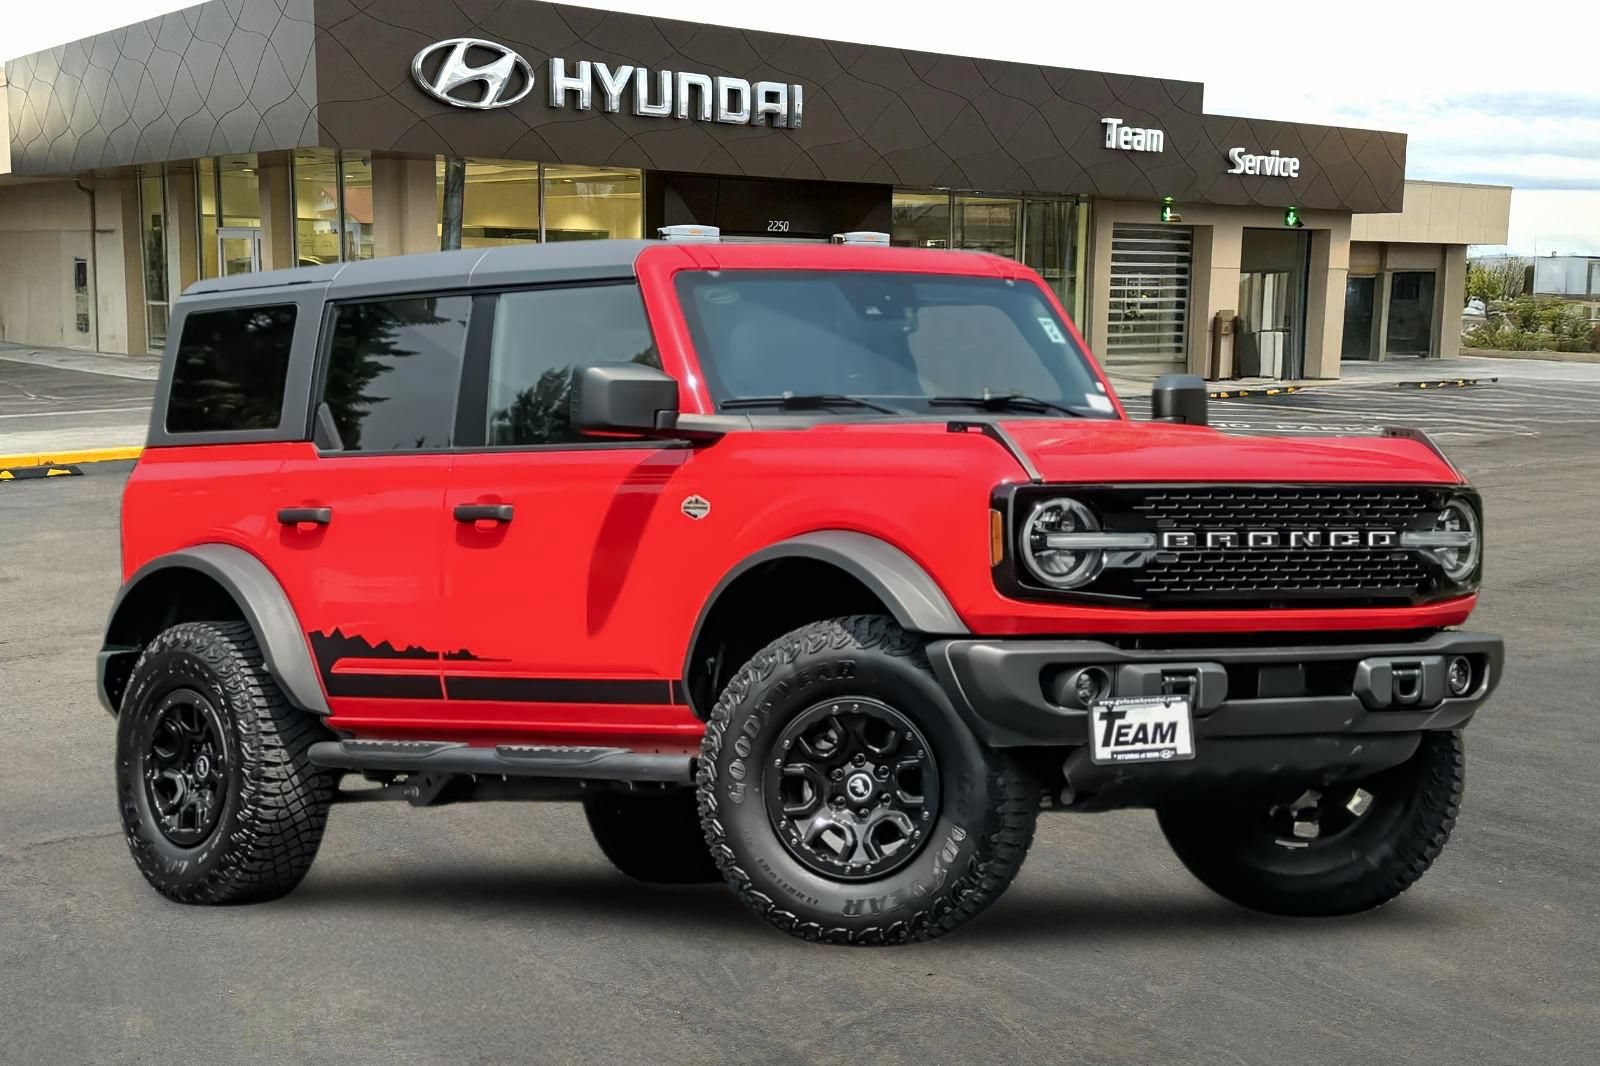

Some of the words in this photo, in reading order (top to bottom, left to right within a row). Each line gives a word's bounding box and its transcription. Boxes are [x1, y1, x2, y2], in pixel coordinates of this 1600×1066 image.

[548, 57, 803, 129] HYUNDAI
[1101, 117, 1164, 152] Team
[1227, 147, 1300, 178] Service
[767, 220, 790, 233] 2250
[1163, 531, 1397, 548] BRONCO
[1098, 711, 1178, 748] TEAM
